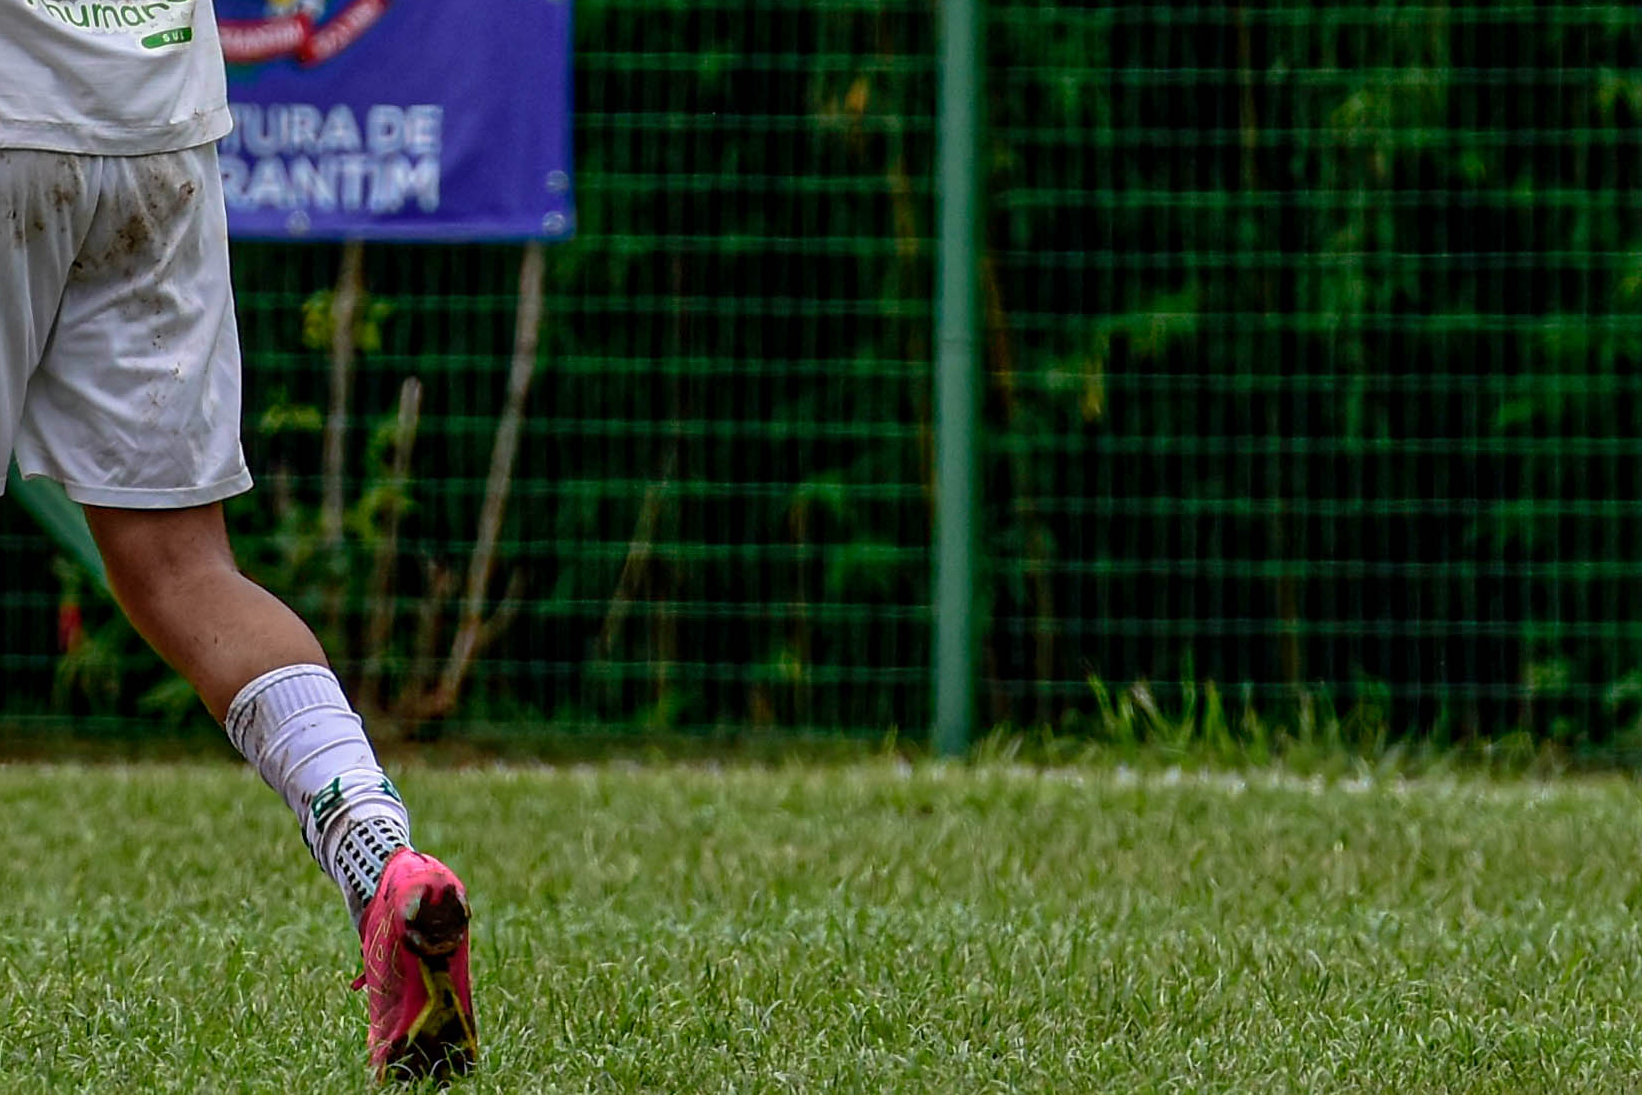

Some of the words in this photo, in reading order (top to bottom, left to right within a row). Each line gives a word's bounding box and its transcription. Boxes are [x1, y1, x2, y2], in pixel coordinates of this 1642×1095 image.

[220, 103, 363, 156] TURA
[366, 103, 444, 156] DE
[220, 154, 440, 214] RANTIM
